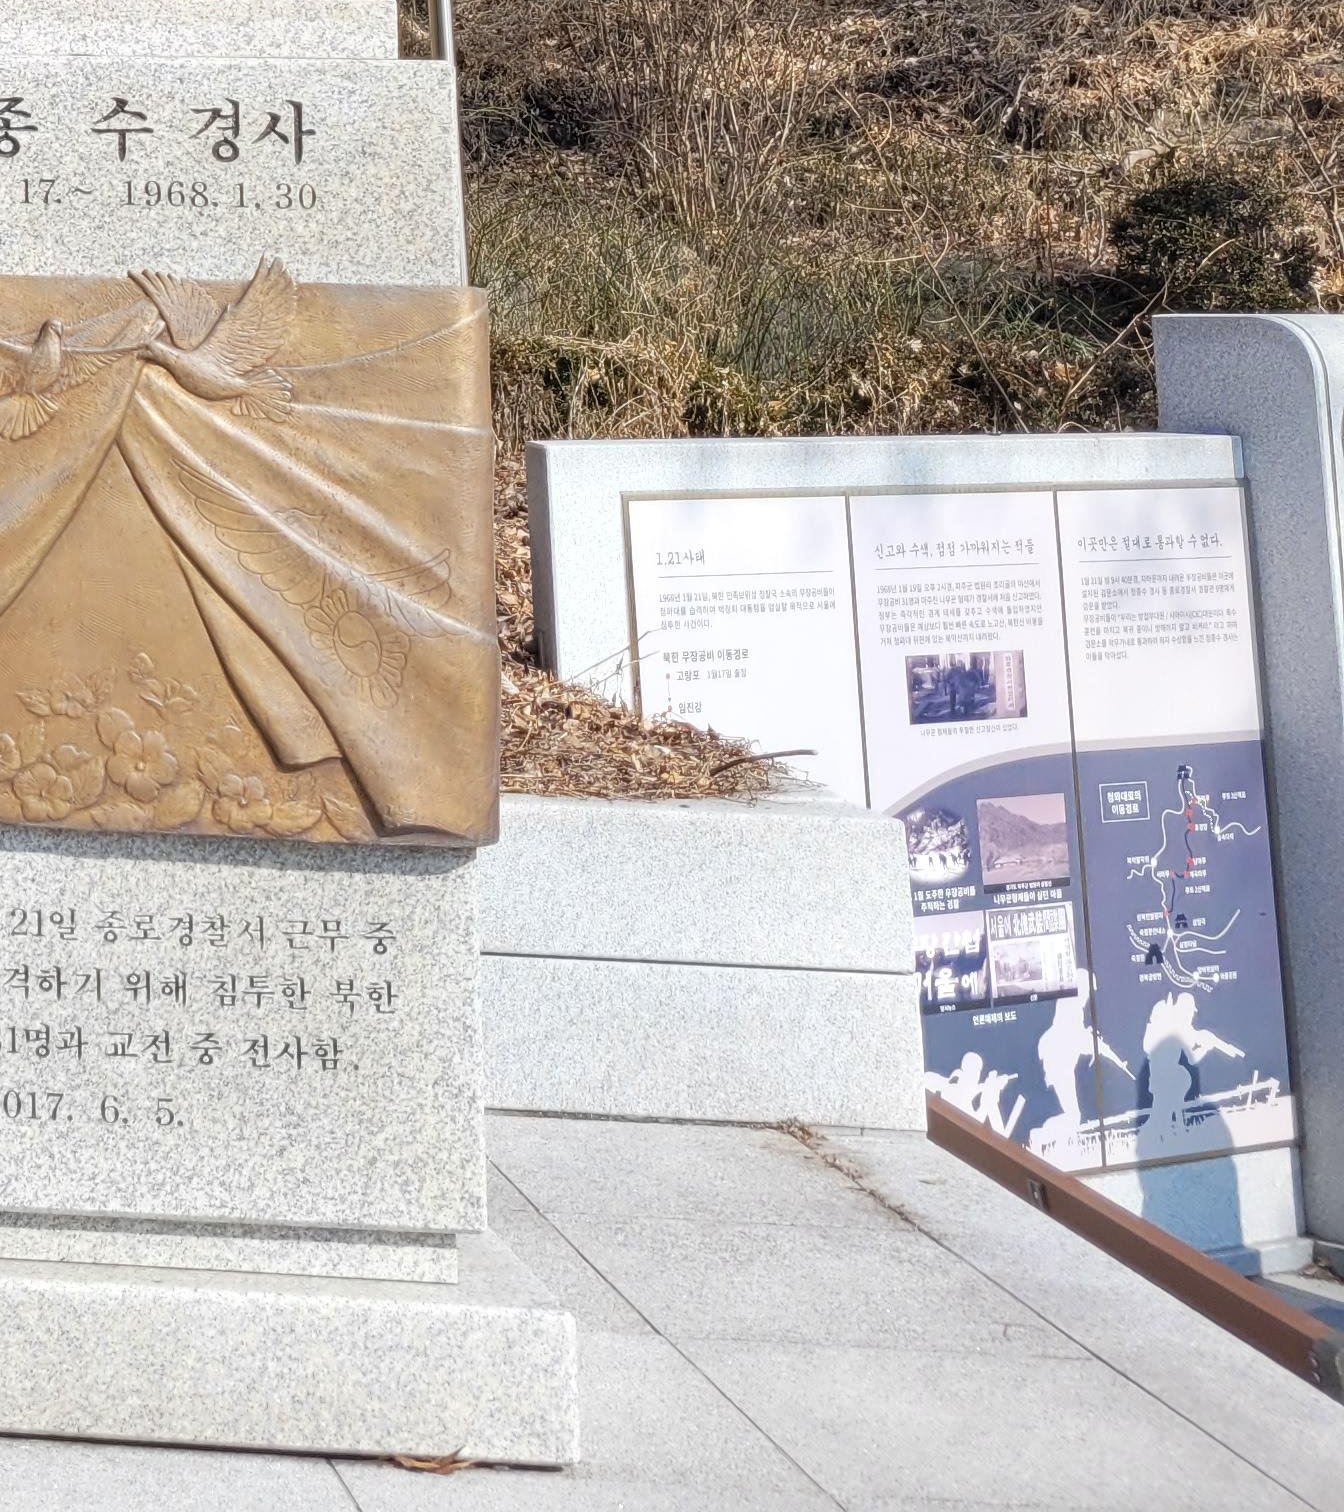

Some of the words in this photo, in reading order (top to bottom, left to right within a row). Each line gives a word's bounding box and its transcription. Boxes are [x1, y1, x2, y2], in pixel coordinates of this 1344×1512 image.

[874, 543, 906, 559] 신고와
[1077, 536, 1118, 552] 이곳만은
[11, 907, 79, 941] 21일
[94, 910, 265, 952] 종로경찰서
[282, 918, 350, 954] 근무
[362, 921, 398, 956] 중
[124, 969, 188, 1007] 위해
[209, 973, 312, 1011] 침투한
[328, 978, 398, 1015] 북한
[105, 1029, 174, 1064] 교전
[190, 1032, 223, 1066] 중
[242, 1033, 360, 1072] 전사함.
